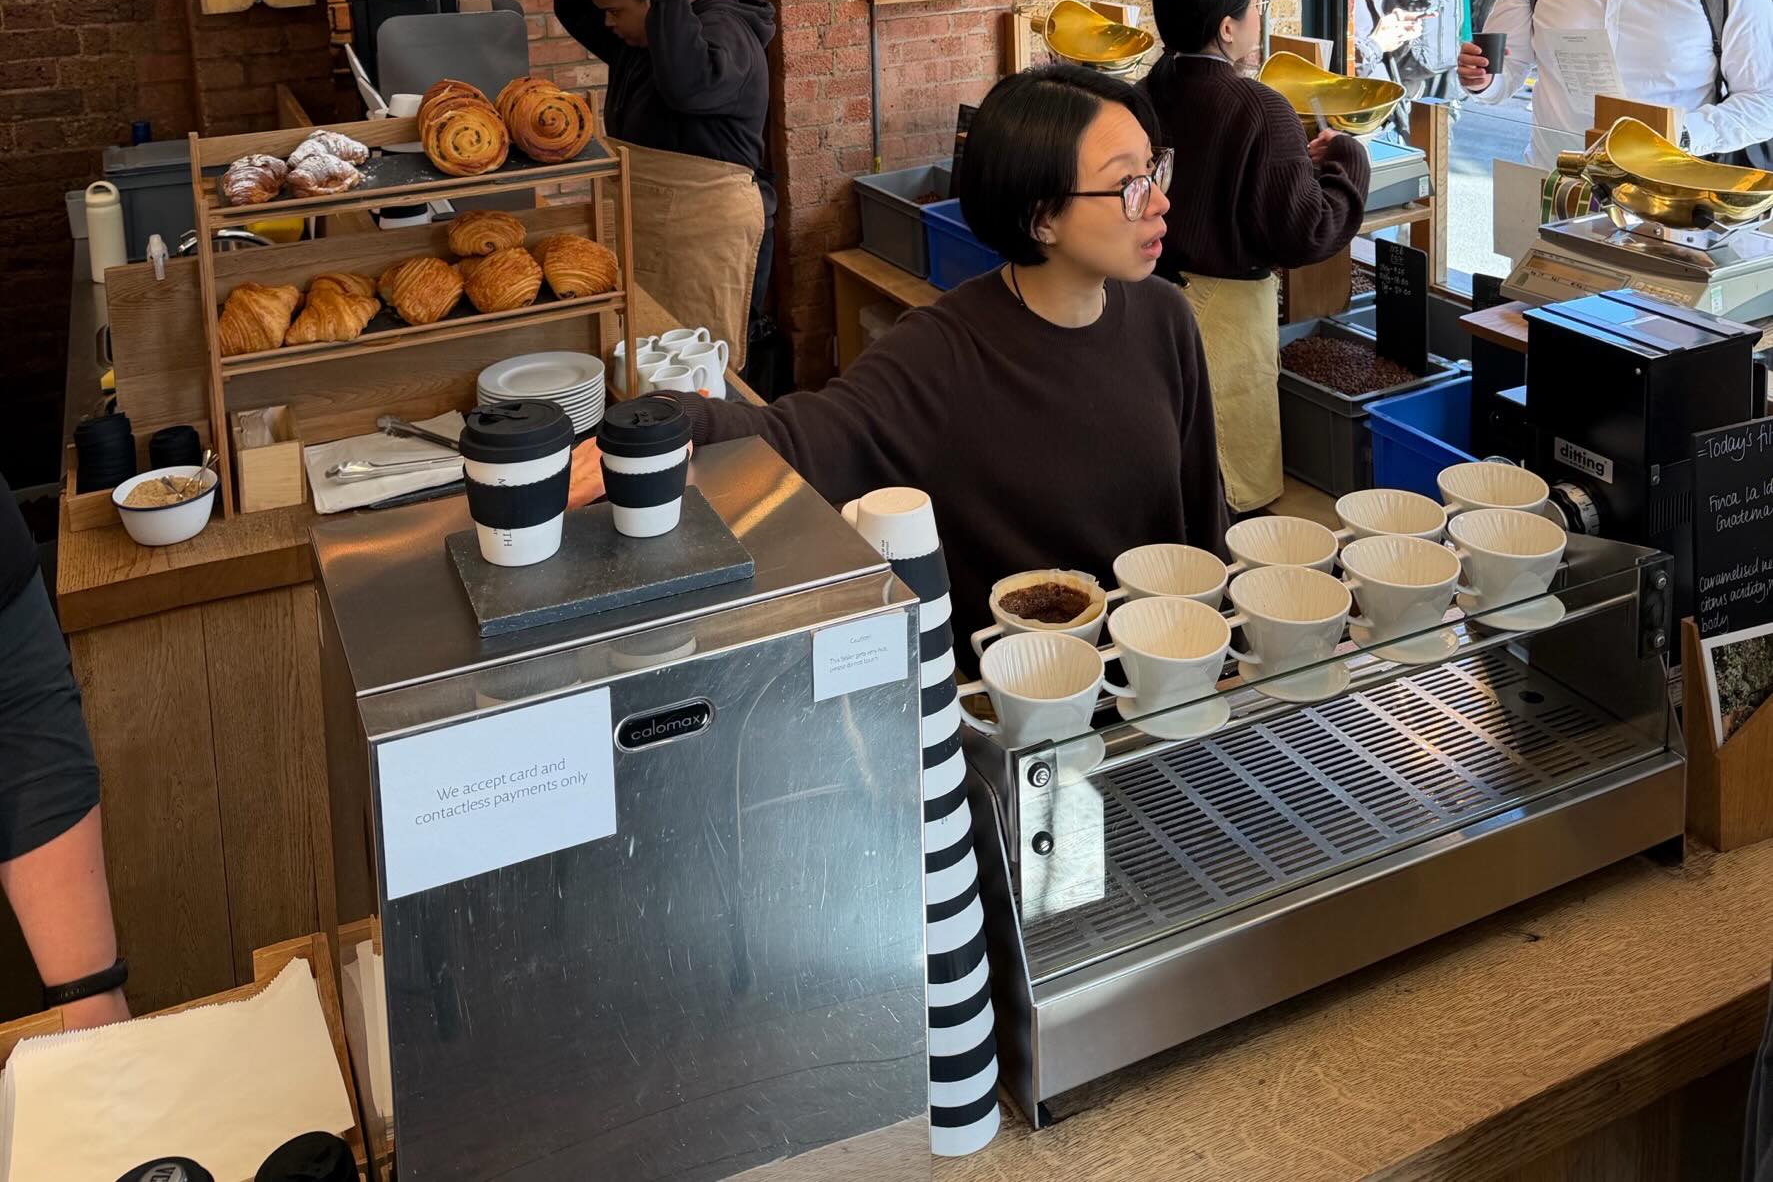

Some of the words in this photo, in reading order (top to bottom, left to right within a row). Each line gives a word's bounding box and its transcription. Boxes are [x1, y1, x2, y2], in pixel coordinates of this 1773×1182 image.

[1560, 443, 1604, 476] ditting
[1709, 492, 1741, 512] Finca
[1716, 504, 1773, 532] Guatema
[1701, 593, 1728, 613] citrus
[1701, 611, 1729, 634] body
[631, 714, 701, 740] calomax
[436, 786, 459, 801] We
[462, 774, 507, 795] accept
[509, 764, 538, 783] card
[541, 758, 566, 775] and
[415, 796, 491, 825] contactless
[494, 780, 558, 807] payments
[560, 771, 588, 787] only
